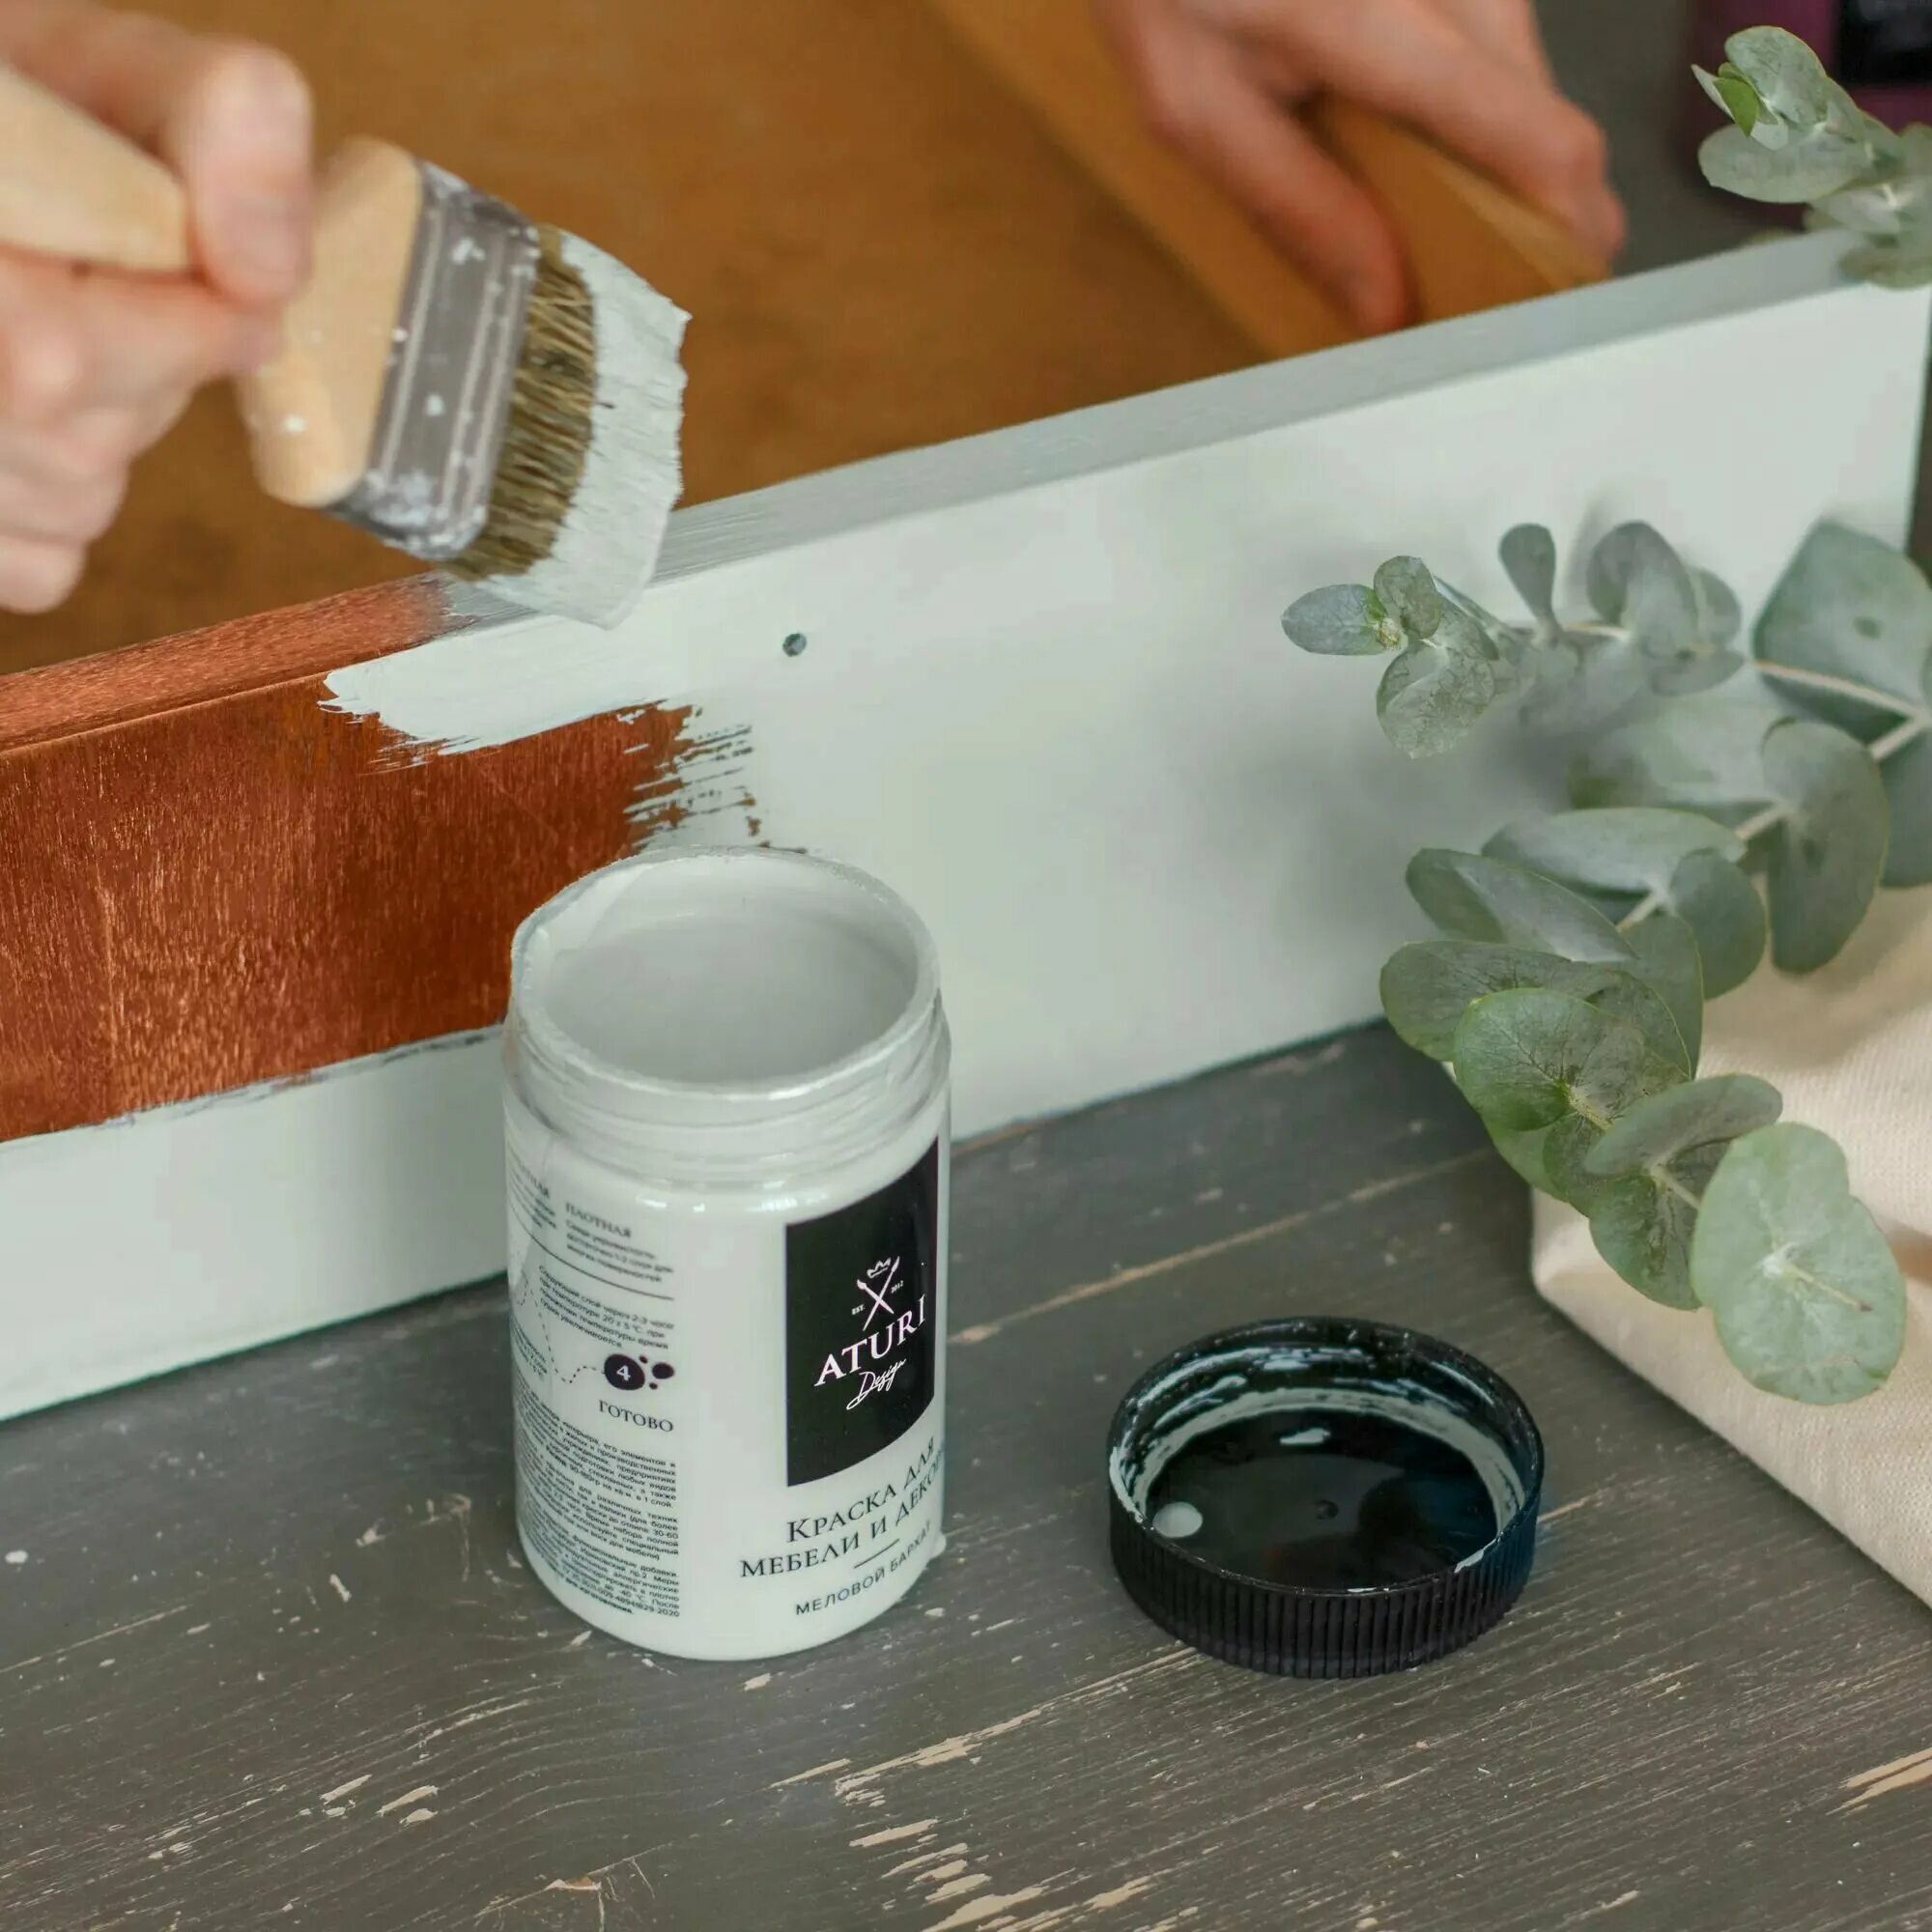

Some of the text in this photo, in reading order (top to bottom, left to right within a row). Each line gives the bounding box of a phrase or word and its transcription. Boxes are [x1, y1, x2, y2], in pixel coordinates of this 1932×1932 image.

[814, 1294, 925, 1386] ATURI
[616, 1365, 631, 1381] 4
[846, 1358, 907, 1410] Design
[598, 1400, 674, 1432] ГОТОВО
[903, 1436, 933, 1490] ДЛЯ
[740, 1448, 943, 1577] МЕБЕЛИ И ДЕКОР
[796, 1566, 885, 1615] МЕЛОВОЙ
